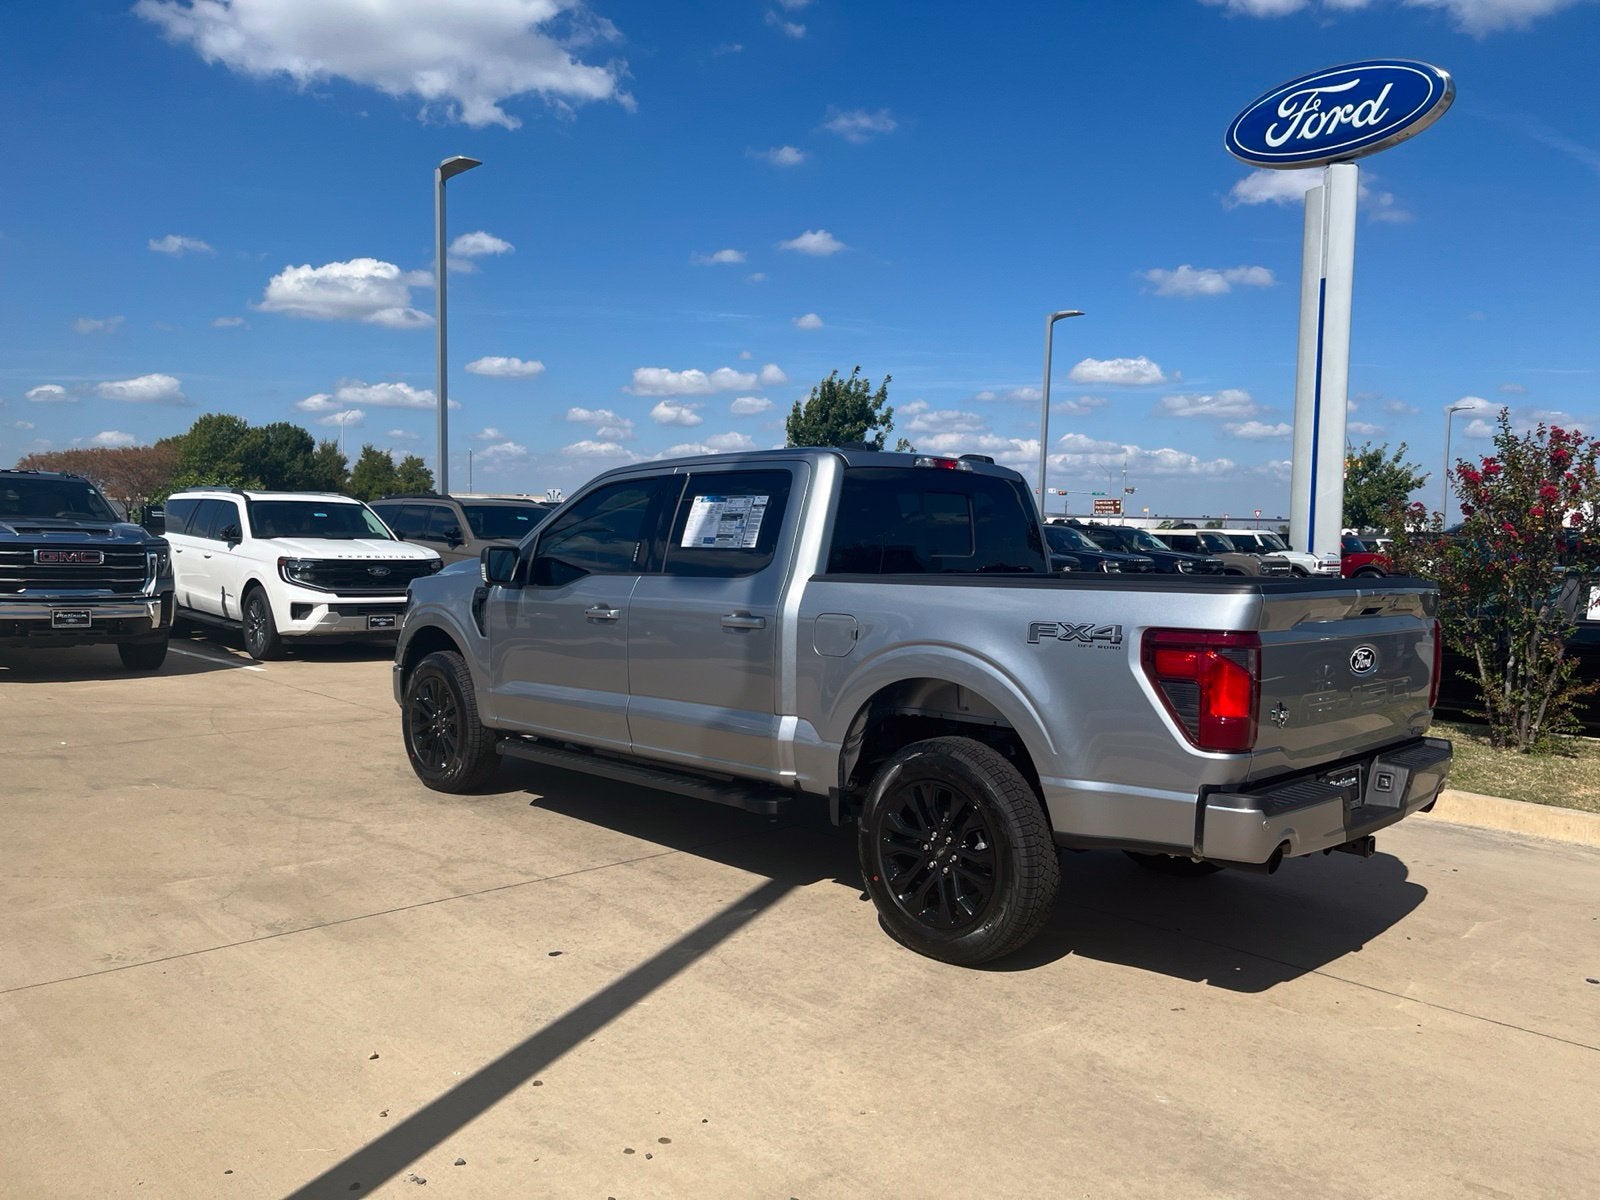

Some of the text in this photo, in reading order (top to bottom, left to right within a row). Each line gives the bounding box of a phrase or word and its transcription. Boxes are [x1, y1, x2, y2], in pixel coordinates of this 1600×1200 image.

[1265, 78, 1394, 148] Ford
[39, 551, 99, 562] GMC
[1027, 621, 1123, 644] FX4
[1355, 651, 1373, 669] Ford
